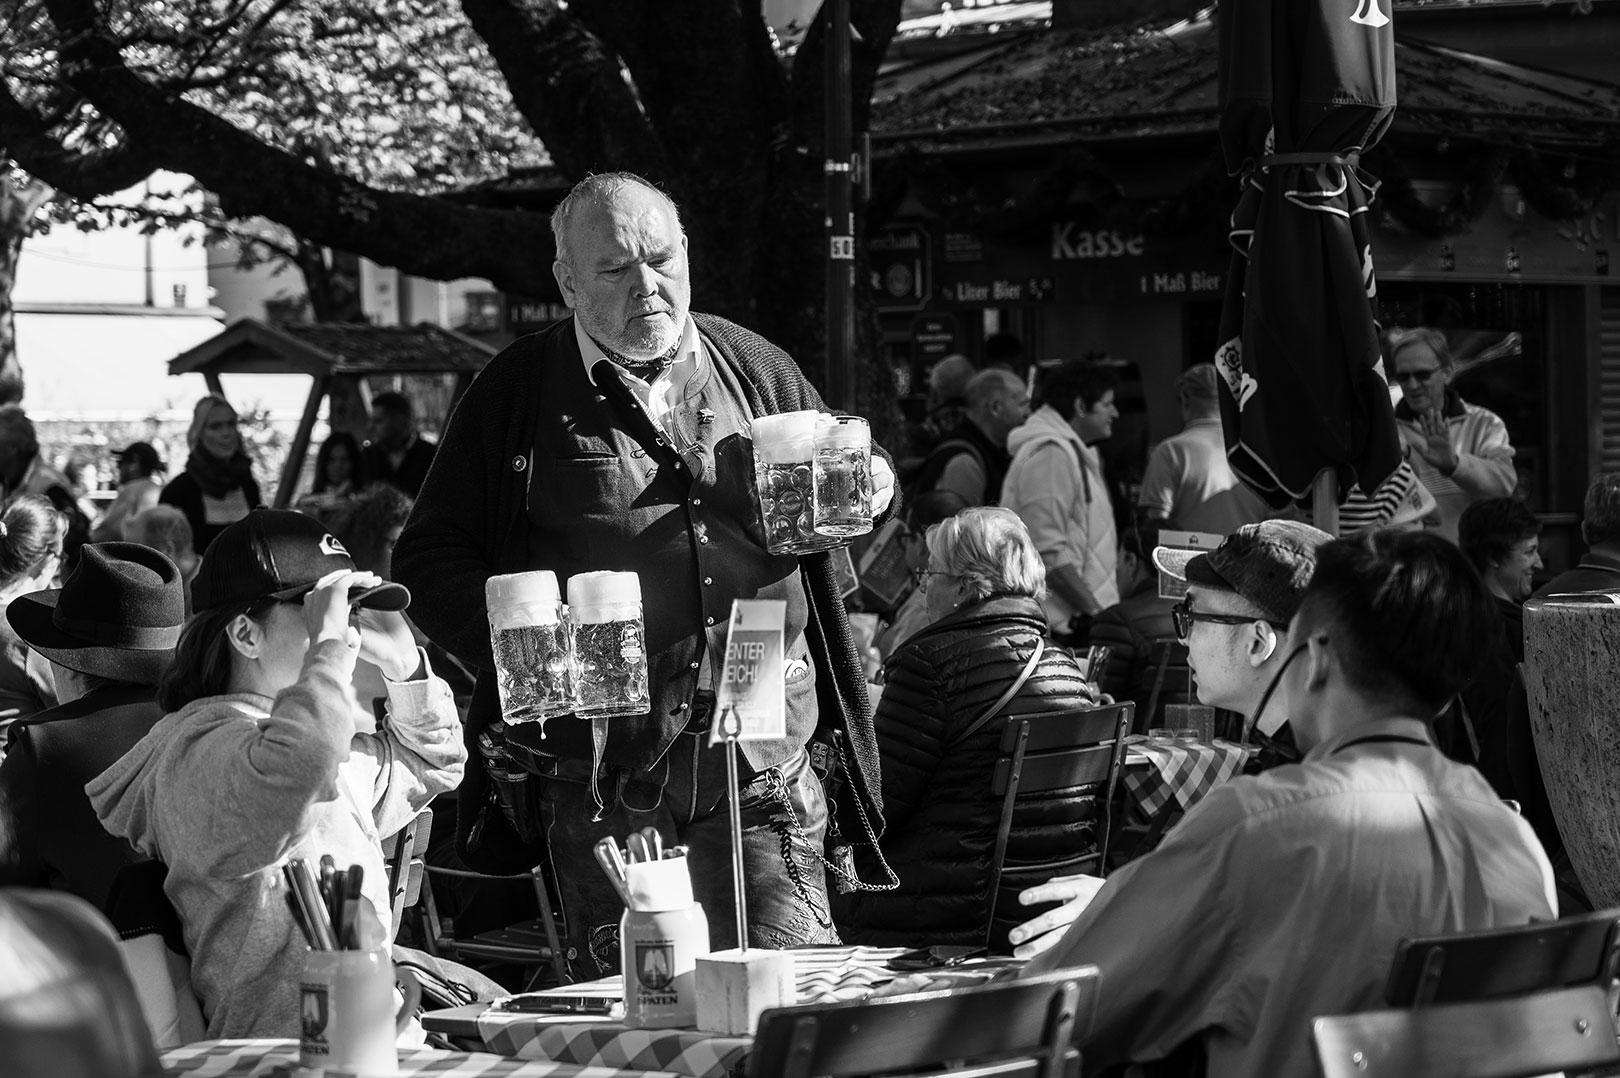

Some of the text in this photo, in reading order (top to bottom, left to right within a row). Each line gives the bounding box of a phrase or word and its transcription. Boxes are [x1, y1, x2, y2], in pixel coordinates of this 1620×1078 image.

[1051, 221, 1145, 260] Kasse
[992, 279, 1022, 300] Bier
[1153, 272, 1186, 293] Maß
[1190, 270, 1222, 291] Bier
